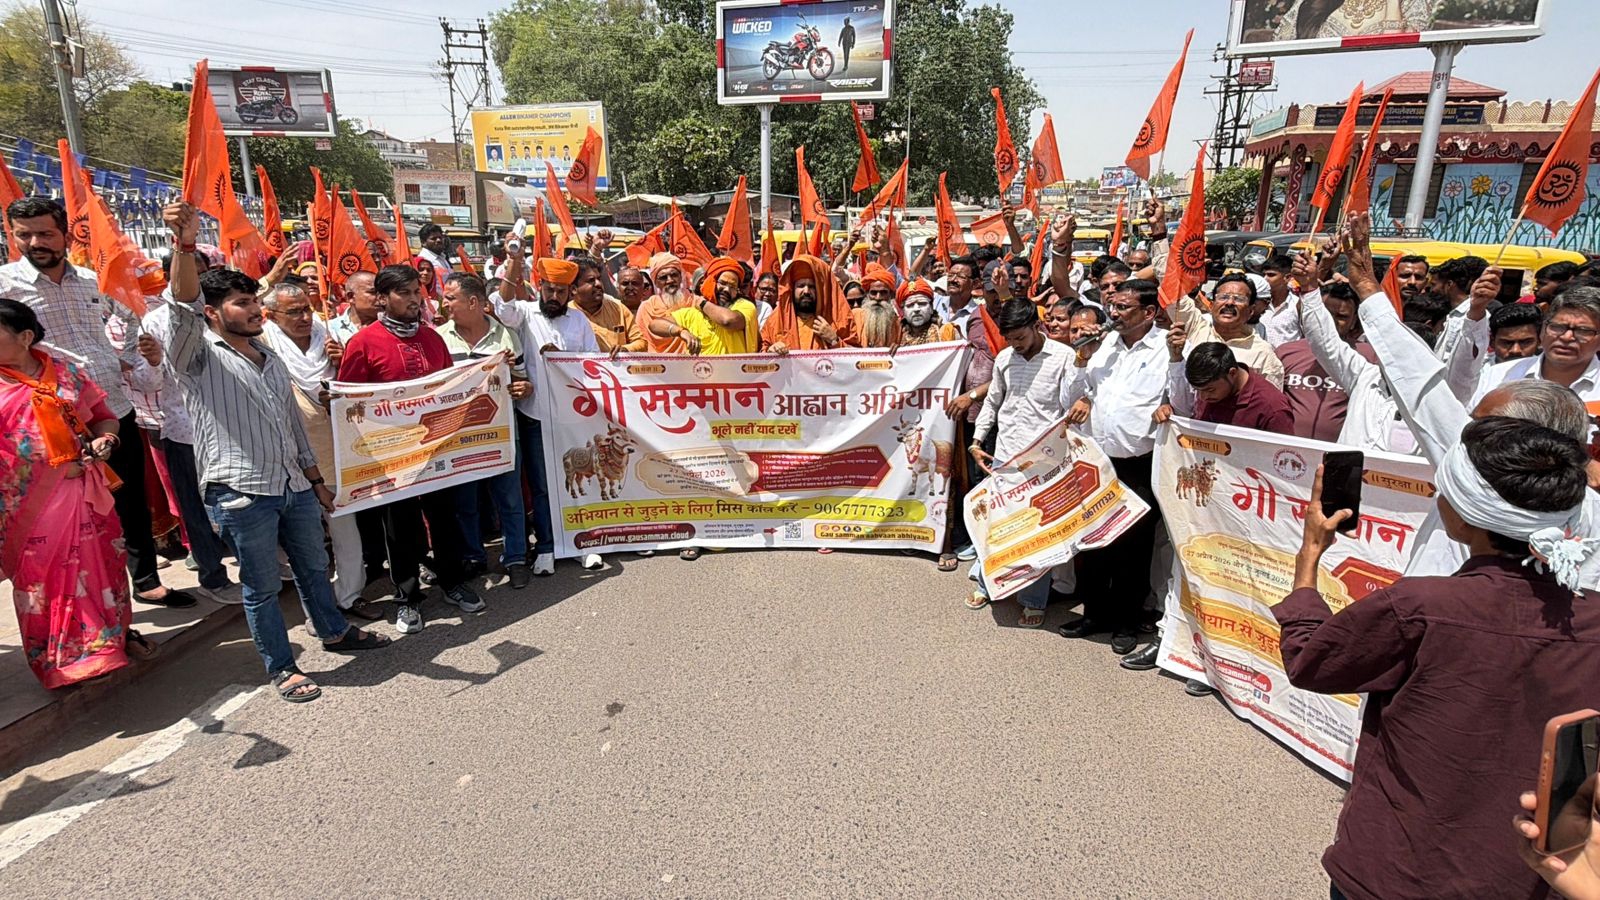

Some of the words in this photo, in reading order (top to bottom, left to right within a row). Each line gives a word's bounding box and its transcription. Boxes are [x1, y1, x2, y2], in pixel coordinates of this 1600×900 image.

[732, 20, 772, 34] WICKED
[256, 76, 280, 88] CLASSIC
[826, 78, 877, 88] RAIDER
[396, 394, 436, 416] सम्मान
[566, 360, 630, 428] गौ
[628, 382, 771, 434] सम्मान
[773, 394, 848, 417] आह्वान
[858, 385, 951, 416] अभियान
[459, 431, 498, 445] 9067777323
[712, 425, 733, 439] भूले
[734, 422, 756, 435] नहीं
[756, 424, 776, 434] याद
[778, 423, 798, 436] रखें
[705, 470, 726, 478] 2026
[1380, 476, 1412, 489] सुरक्षा
[1005, 475, 1040, 502] सम्मान
[1230, 467, 1280, 522] गौ
[567, 507, 619, 524] अभियान
[622, 504, 635, 516] से
[638, 502, 668, 521] जुड़ने
[672, 501, 684, 515] के
[688, 500, 713, 517] लिए
[716, 500, 742, 514] मिस
[814, 502, 904, 518] 9067777323
[1214, 556, 1231, 566] 2026
[1271, 575, 1290, 586] 2026
[1239, 620, 1253, 638] से
